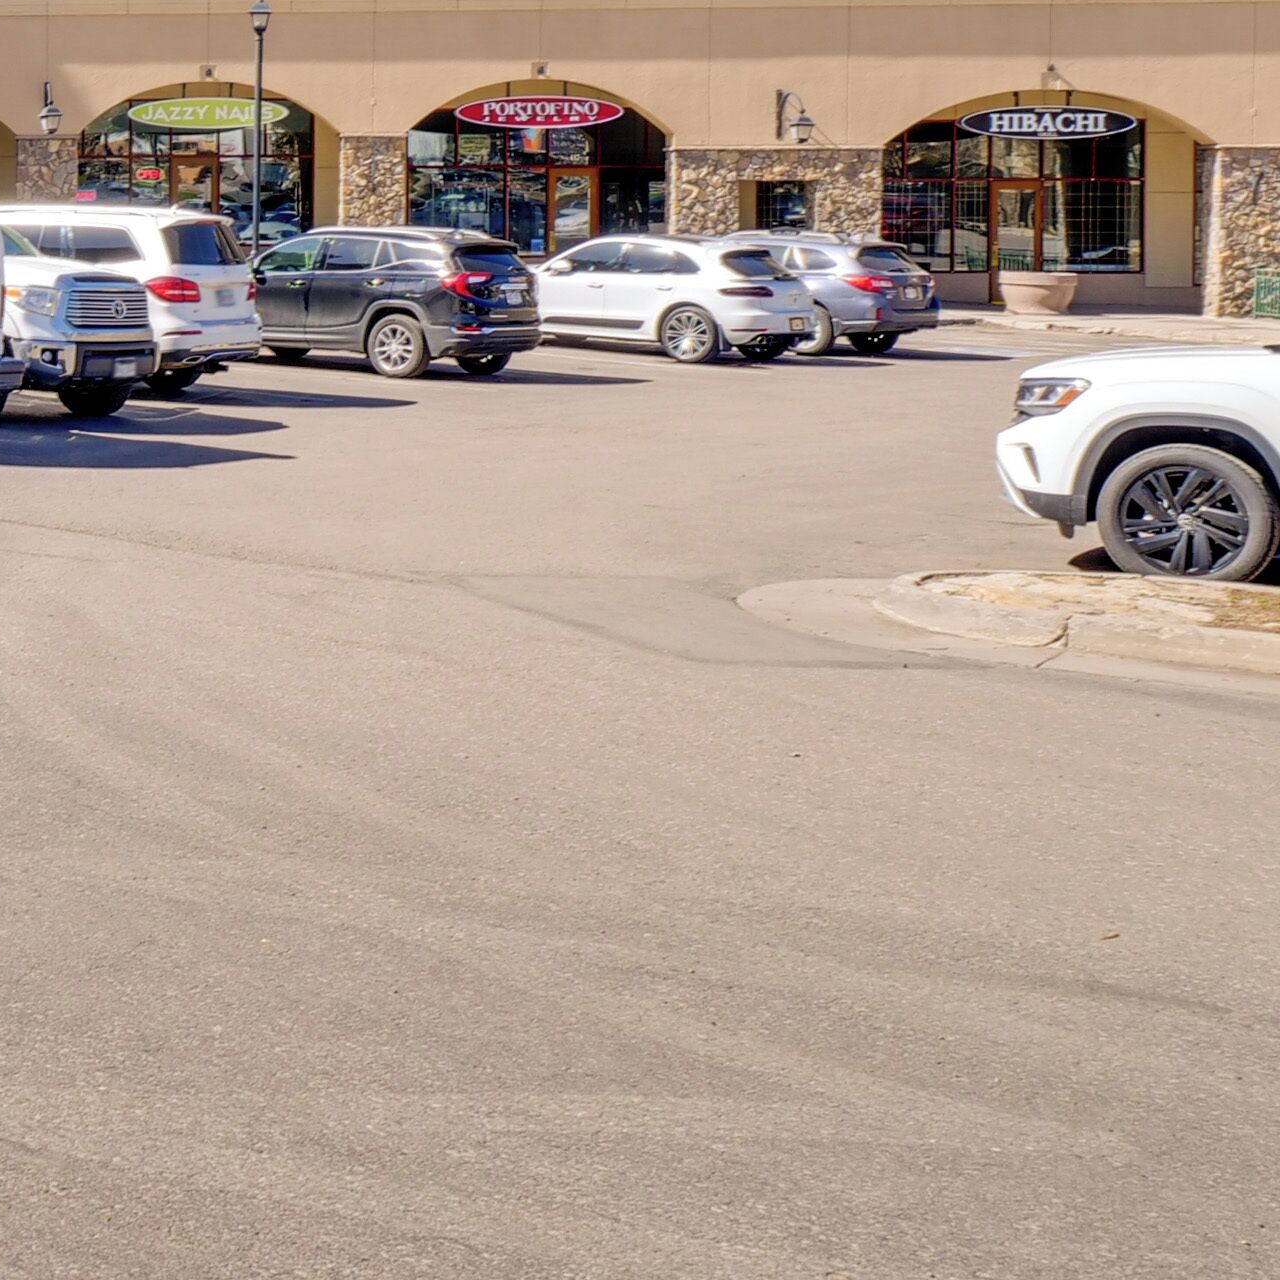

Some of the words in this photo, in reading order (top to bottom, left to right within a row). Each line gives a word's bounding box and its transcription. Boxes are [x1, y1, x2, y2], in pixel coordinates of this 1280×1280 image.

[142, 105, 210, 122] JAZZY
[482, 102, 599, 119] PORTOFINO
[989, 113, 1108, 132] HIBACHI
